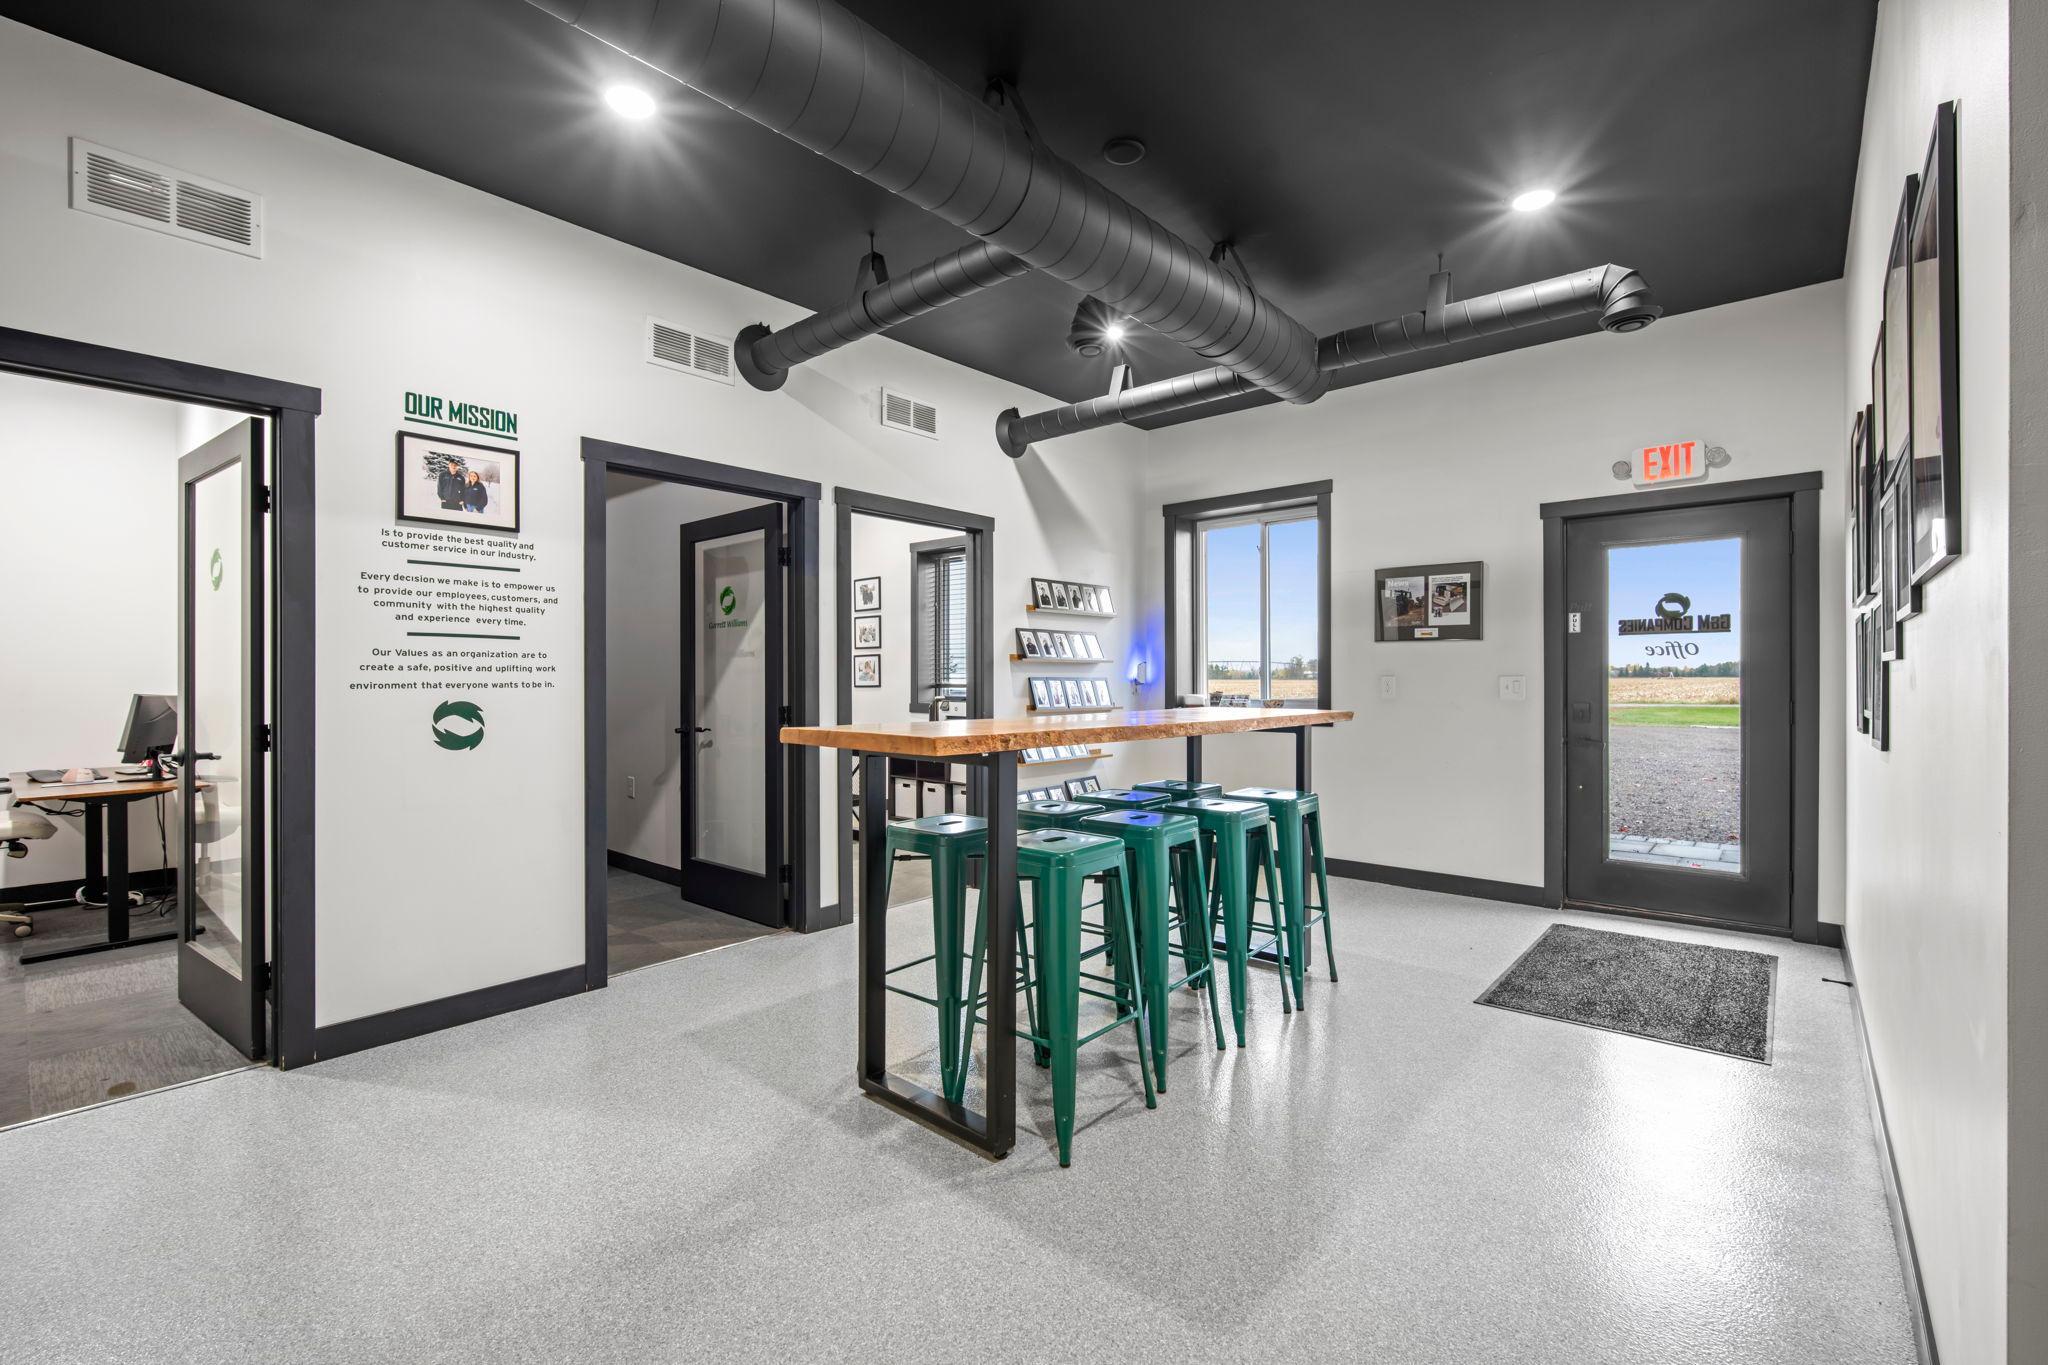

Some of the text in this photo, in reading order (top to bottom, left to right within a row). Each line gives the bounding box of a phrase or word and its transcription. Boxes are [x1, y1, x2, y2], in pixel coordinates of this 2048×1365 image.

[405, 391, 518, 434] OUR MISSION
[1643, 441, 1696, 481] EXIT
[381, 528, 534, 551] Is to provide the best quality and
[381, 540, 537, 562] customer service in our industry.
[360, 571, 391, 583] Every
[392, 573, 435, 584] decision
[453, 579, 479, 587] make
[481, 579, 490, 588] is
[491, 580, 501, 589] to
[503, 582, 543, 591] empower
[357, 585, 369, 594] to
[373, 587, 413, 596] provide
[436, 591, 490, 602] employees,
[490, 594, 541, 604] customers,
[543, 597, 559, 605] and
[373, 600, 546, 616] community with the highest quality
[394, 613, 527, 626] and experience every time.
[371, 647, 392, 657] Our
[394, 648, 429, 657] Values
[460, 650, 519, 659] organization
[538, 651, 548, 659] to
[359, 663, 395, 672] create
[397, 664, 404, 672] a
[407, 663, 432, 672] safe,
[433, 663, 473, 673] positive
[475, 665, 493, 673] and
[495, 664, 533, 674] uplifting
[349, 680, 556, 691] environment that everyone wants to be in.
